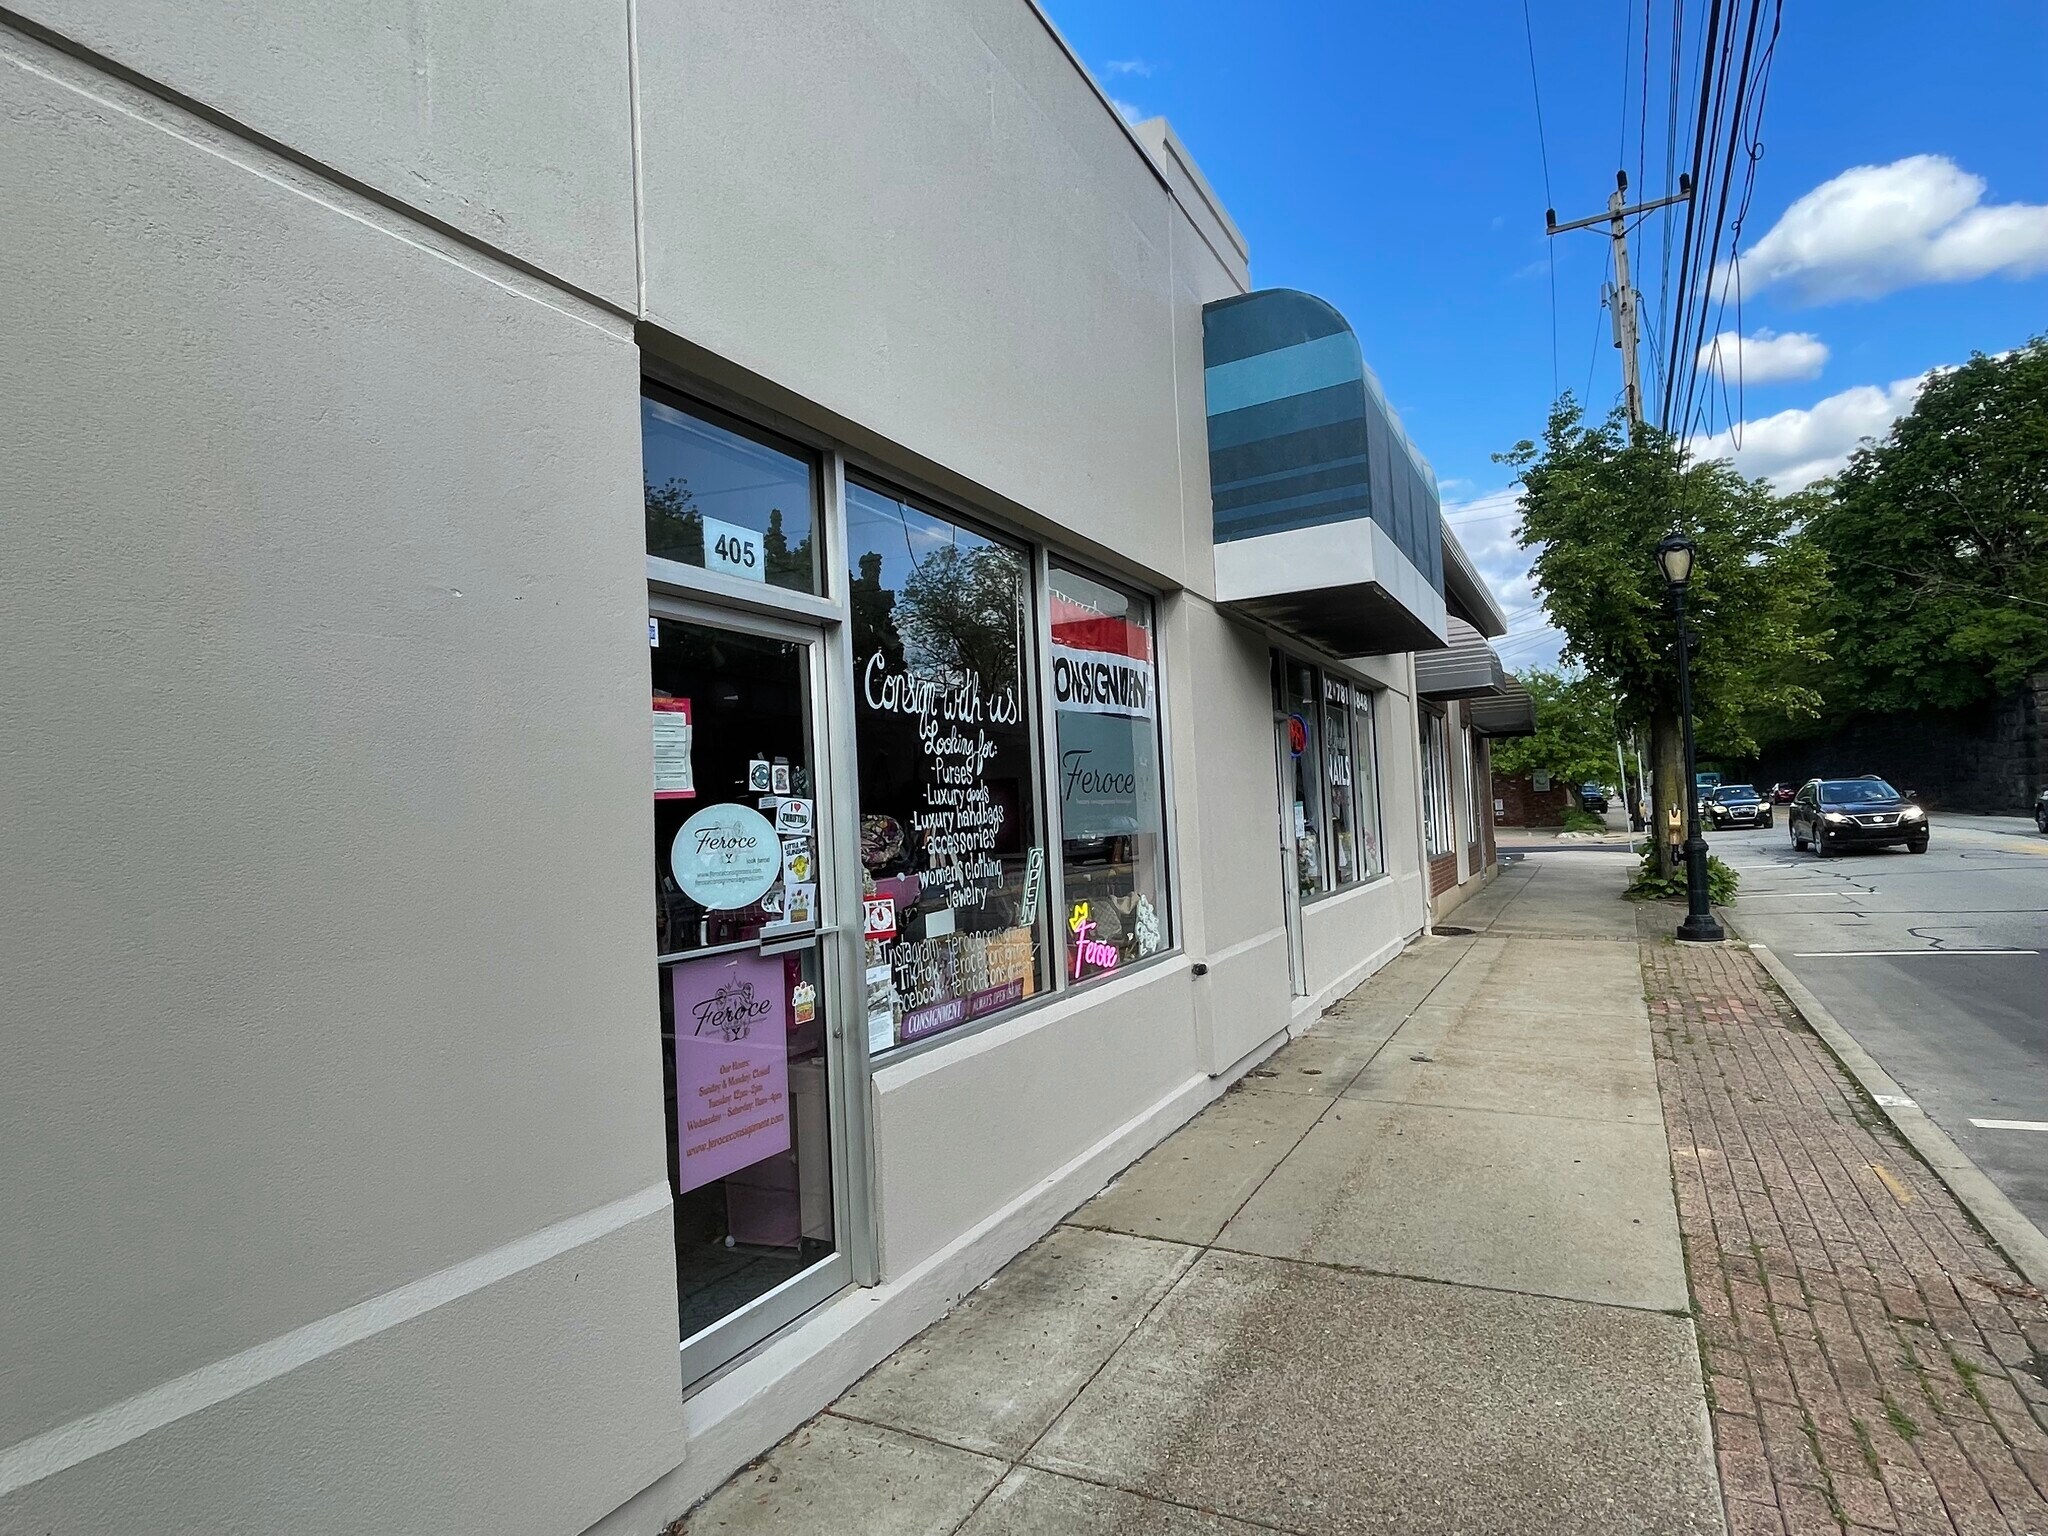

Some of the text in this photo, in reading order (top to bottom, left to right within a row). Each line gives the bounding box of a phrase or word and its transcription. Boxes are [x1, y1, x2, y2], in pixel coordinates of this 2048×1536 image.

[714, 533, 756, 568] 405
[864, 648, 938, 740] Consign
[941, 667, 984, 724] with
[924, 719, 998, 776] Looking for:
[1062, 749, 1136, 801] Feroce
[956, 801, 1005, 834] handbags
[694, 826, 758, 854] Feroce
[964, 851, 1004, 889] clothing
[1024, 851, 1041, 924] OPEN
[1075, 919, 1118, 979] Feroce
[692, 996, 773, 1037] Feroce
[908, 1000, 962, 1034] CONSIGNMENT
[698, 1083, 721, 1097] Sunday
[721, 1079, 727, 1089] &
[752, 1064, 771, 1079] Closed
